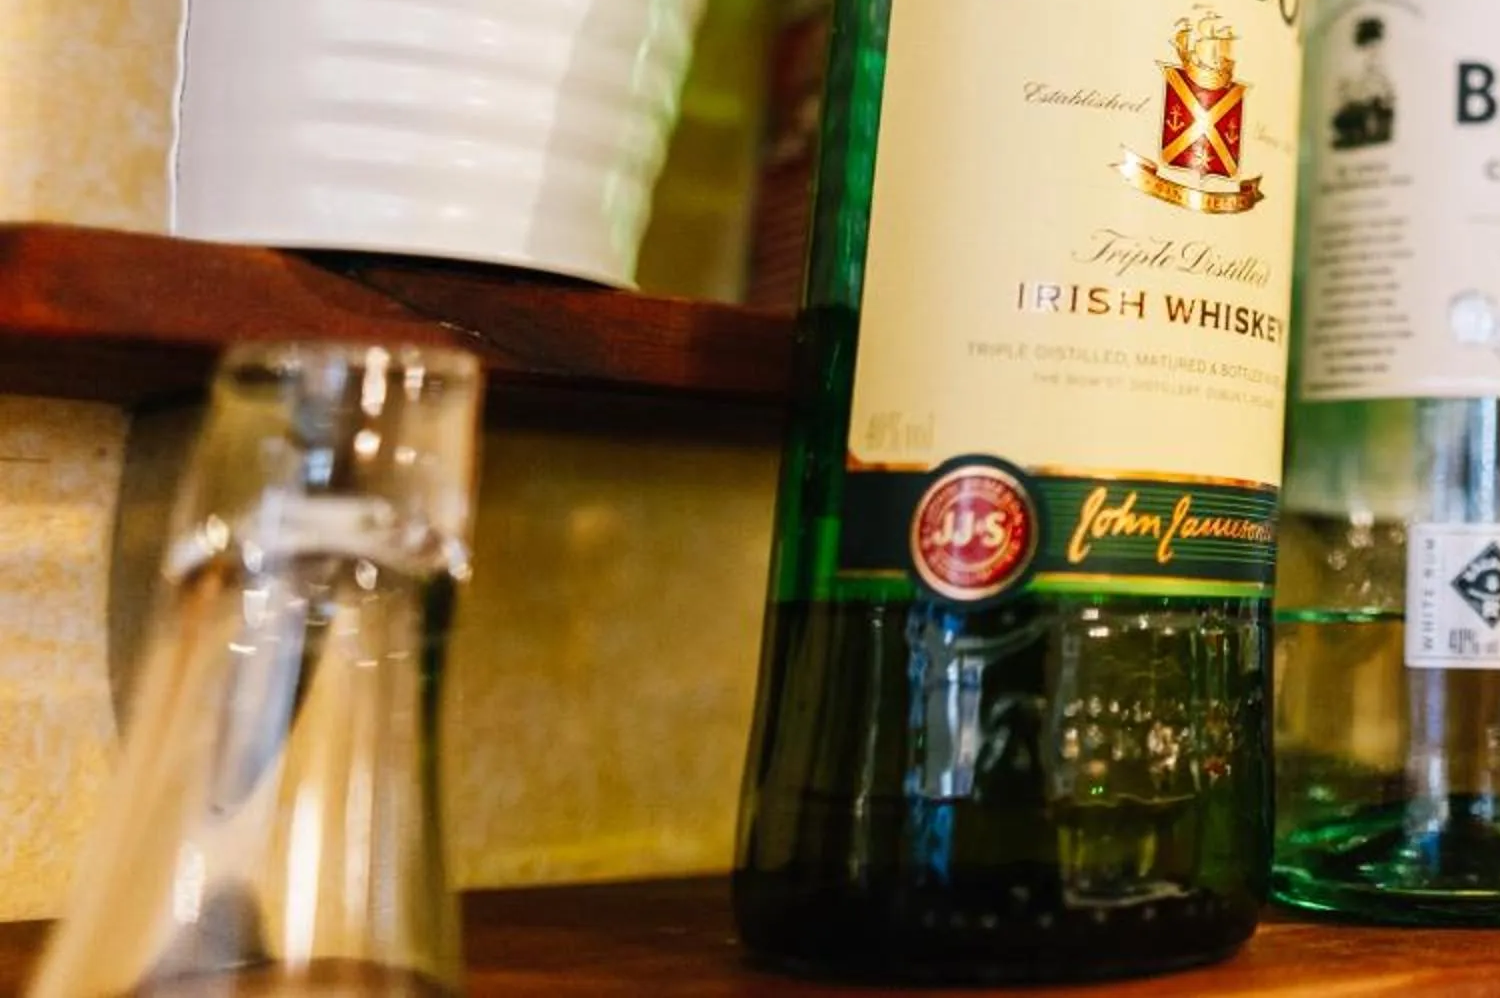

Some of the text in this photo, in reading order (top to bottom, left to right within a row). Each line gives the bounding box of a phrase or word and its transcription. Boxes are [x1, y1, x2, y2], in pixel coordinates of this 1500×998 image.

[1023, 81, 1151, 114] Established
[1071, 228, 1271, 288] Triple Distilled
[1017, 281, 1146, 319] IRISH
[1066, 486, 1163, 564] John
